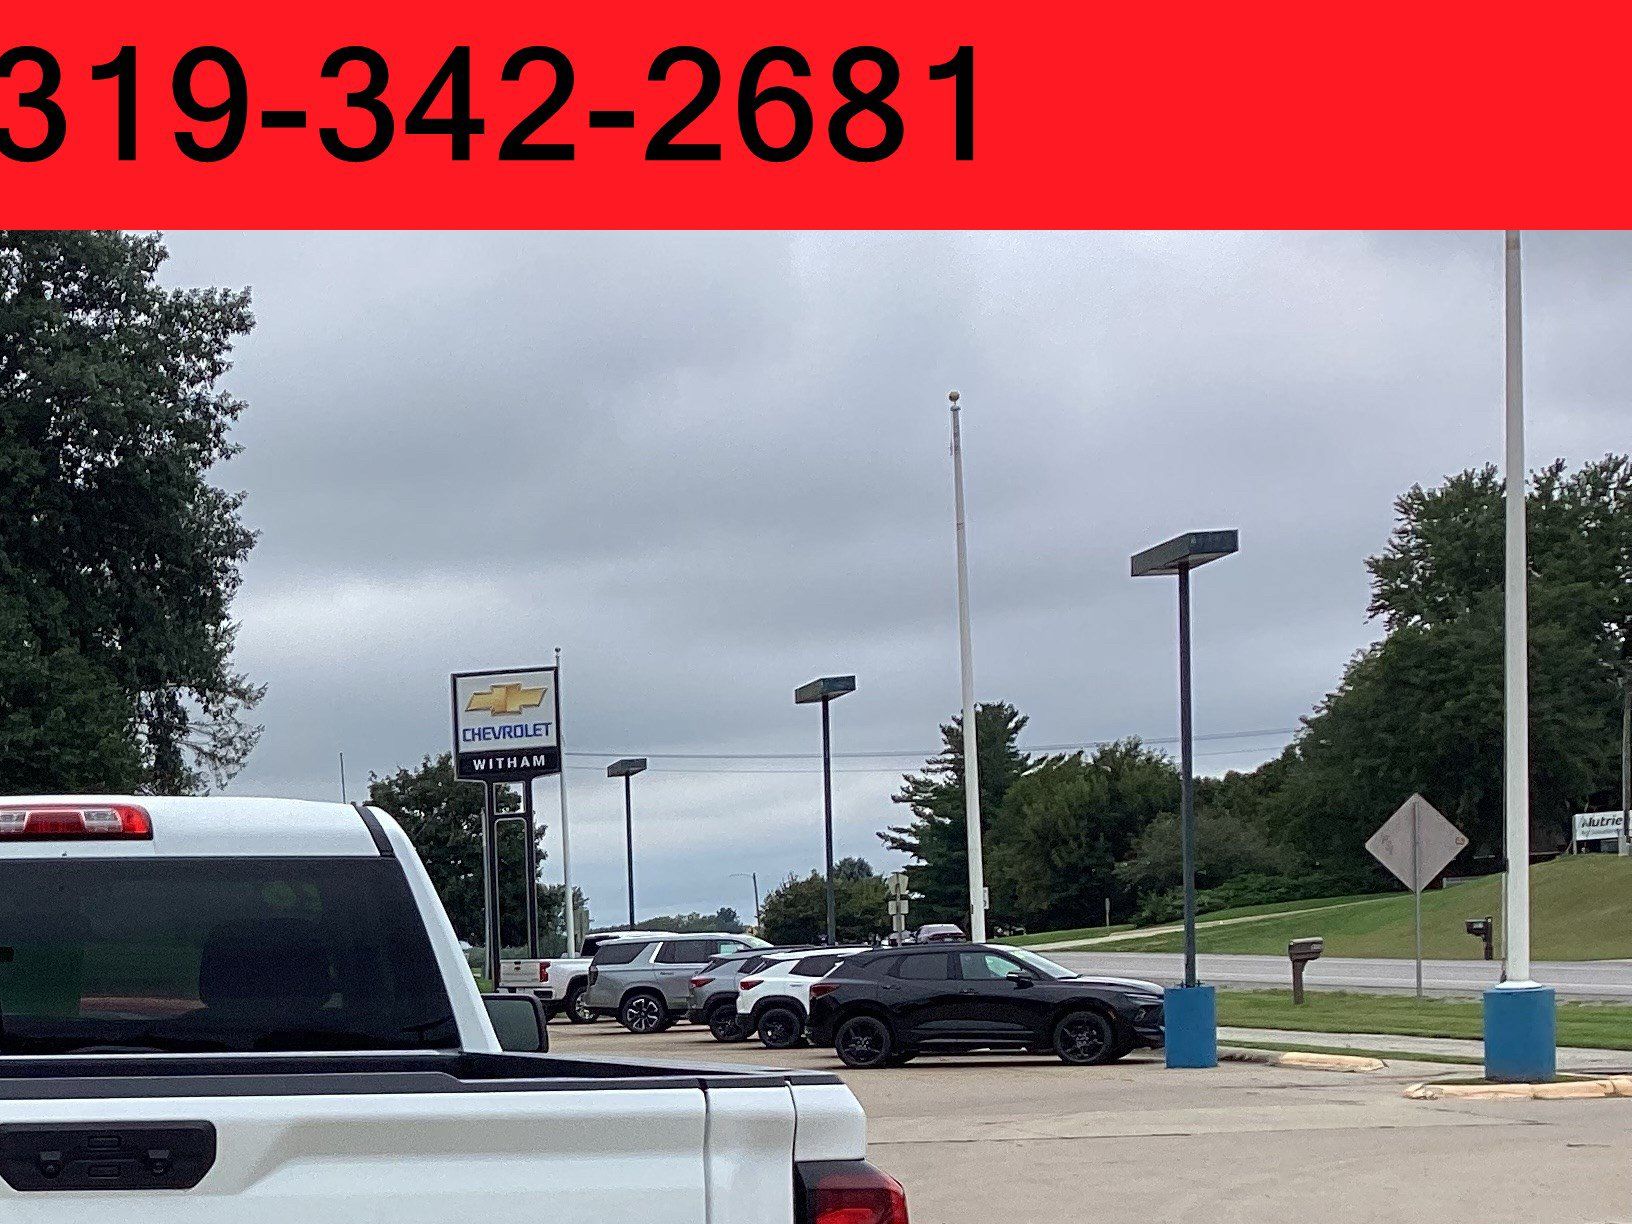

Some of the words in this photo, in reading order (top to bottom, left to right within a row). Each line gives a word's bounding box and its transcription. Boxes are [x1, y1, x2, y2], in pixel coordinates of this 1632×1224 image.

[462, 722, 553, 742] CHEVROLET
[473, 755, 546, 771] WITHAM
[1580, 815, 1625, 828] Nutrie
